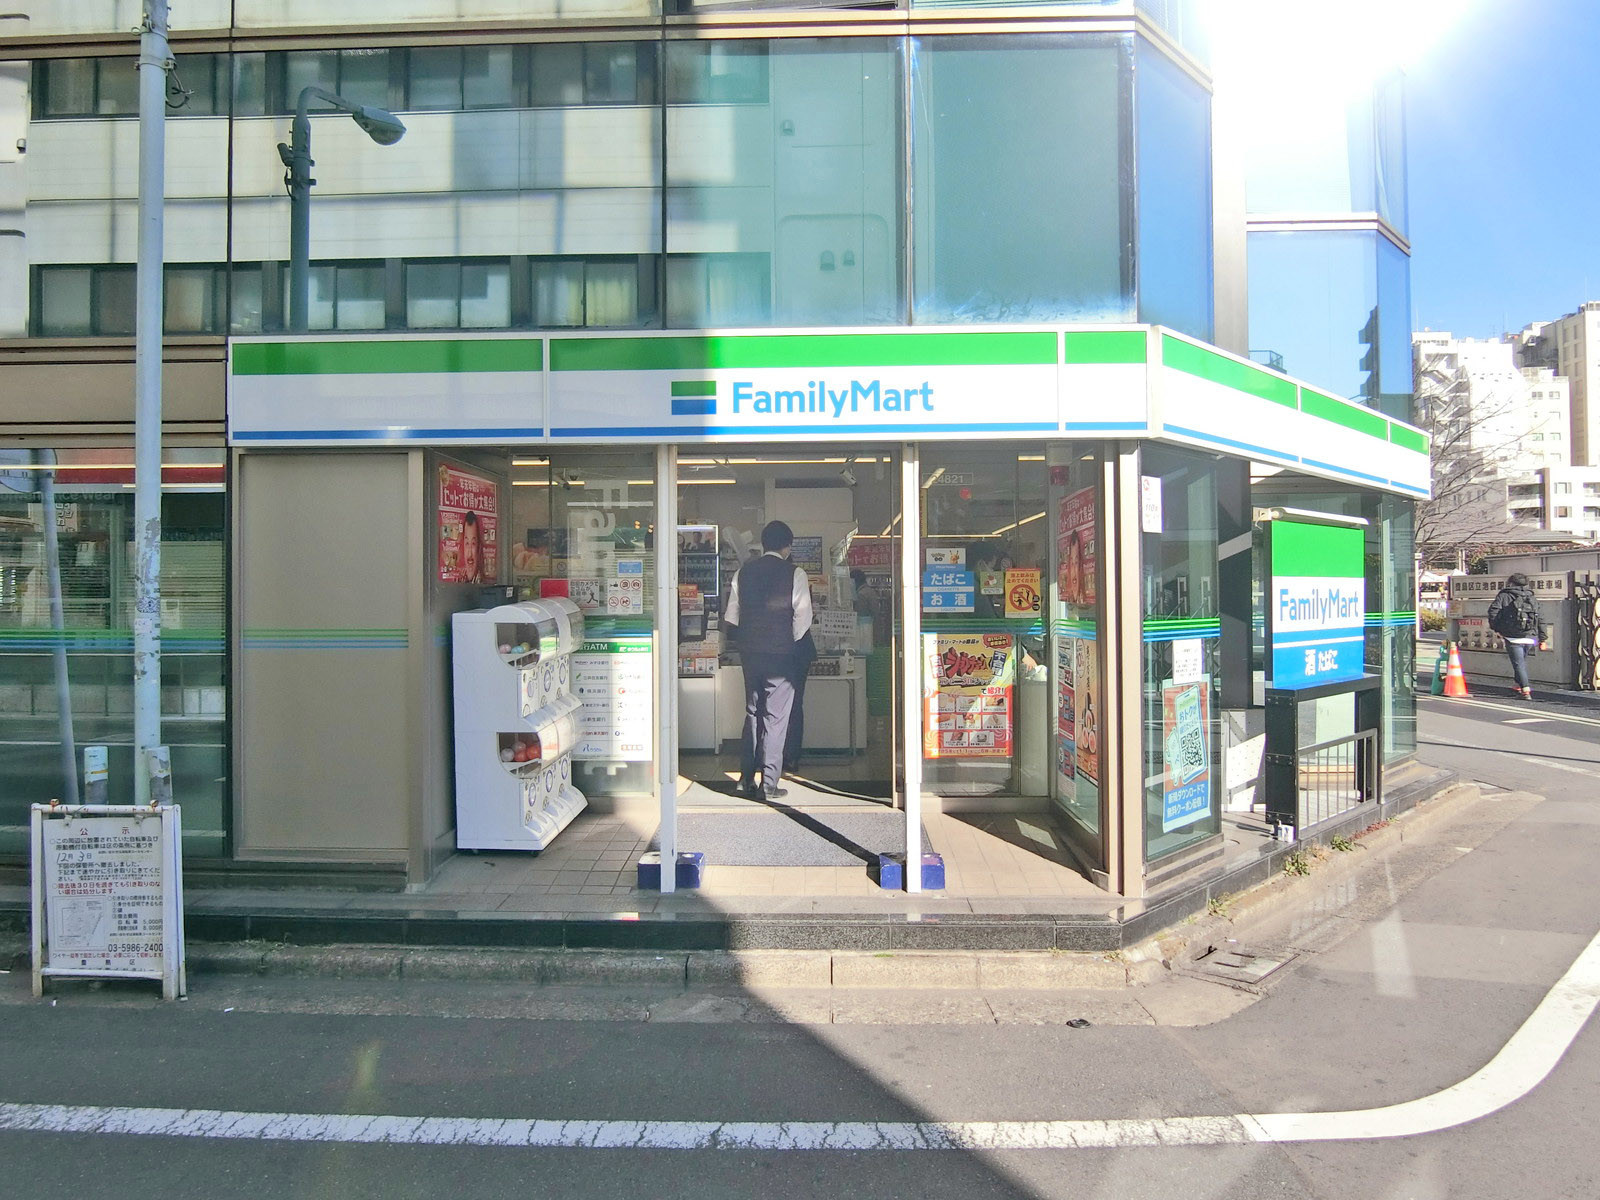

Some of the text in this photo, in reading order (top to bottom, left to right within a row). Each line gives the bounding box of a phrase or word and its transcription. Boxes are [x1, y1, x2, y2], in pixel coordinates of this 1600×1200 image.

[733, 380, 934, 418] FamilyMart
[930, 573, 966, 586] たばこ
[1279, 588, 1359, 624] FamilyMart
[1304, 649, 1339, 676] 酒 たばこ
[107, 943, 164, 953] 03-5986-2400
